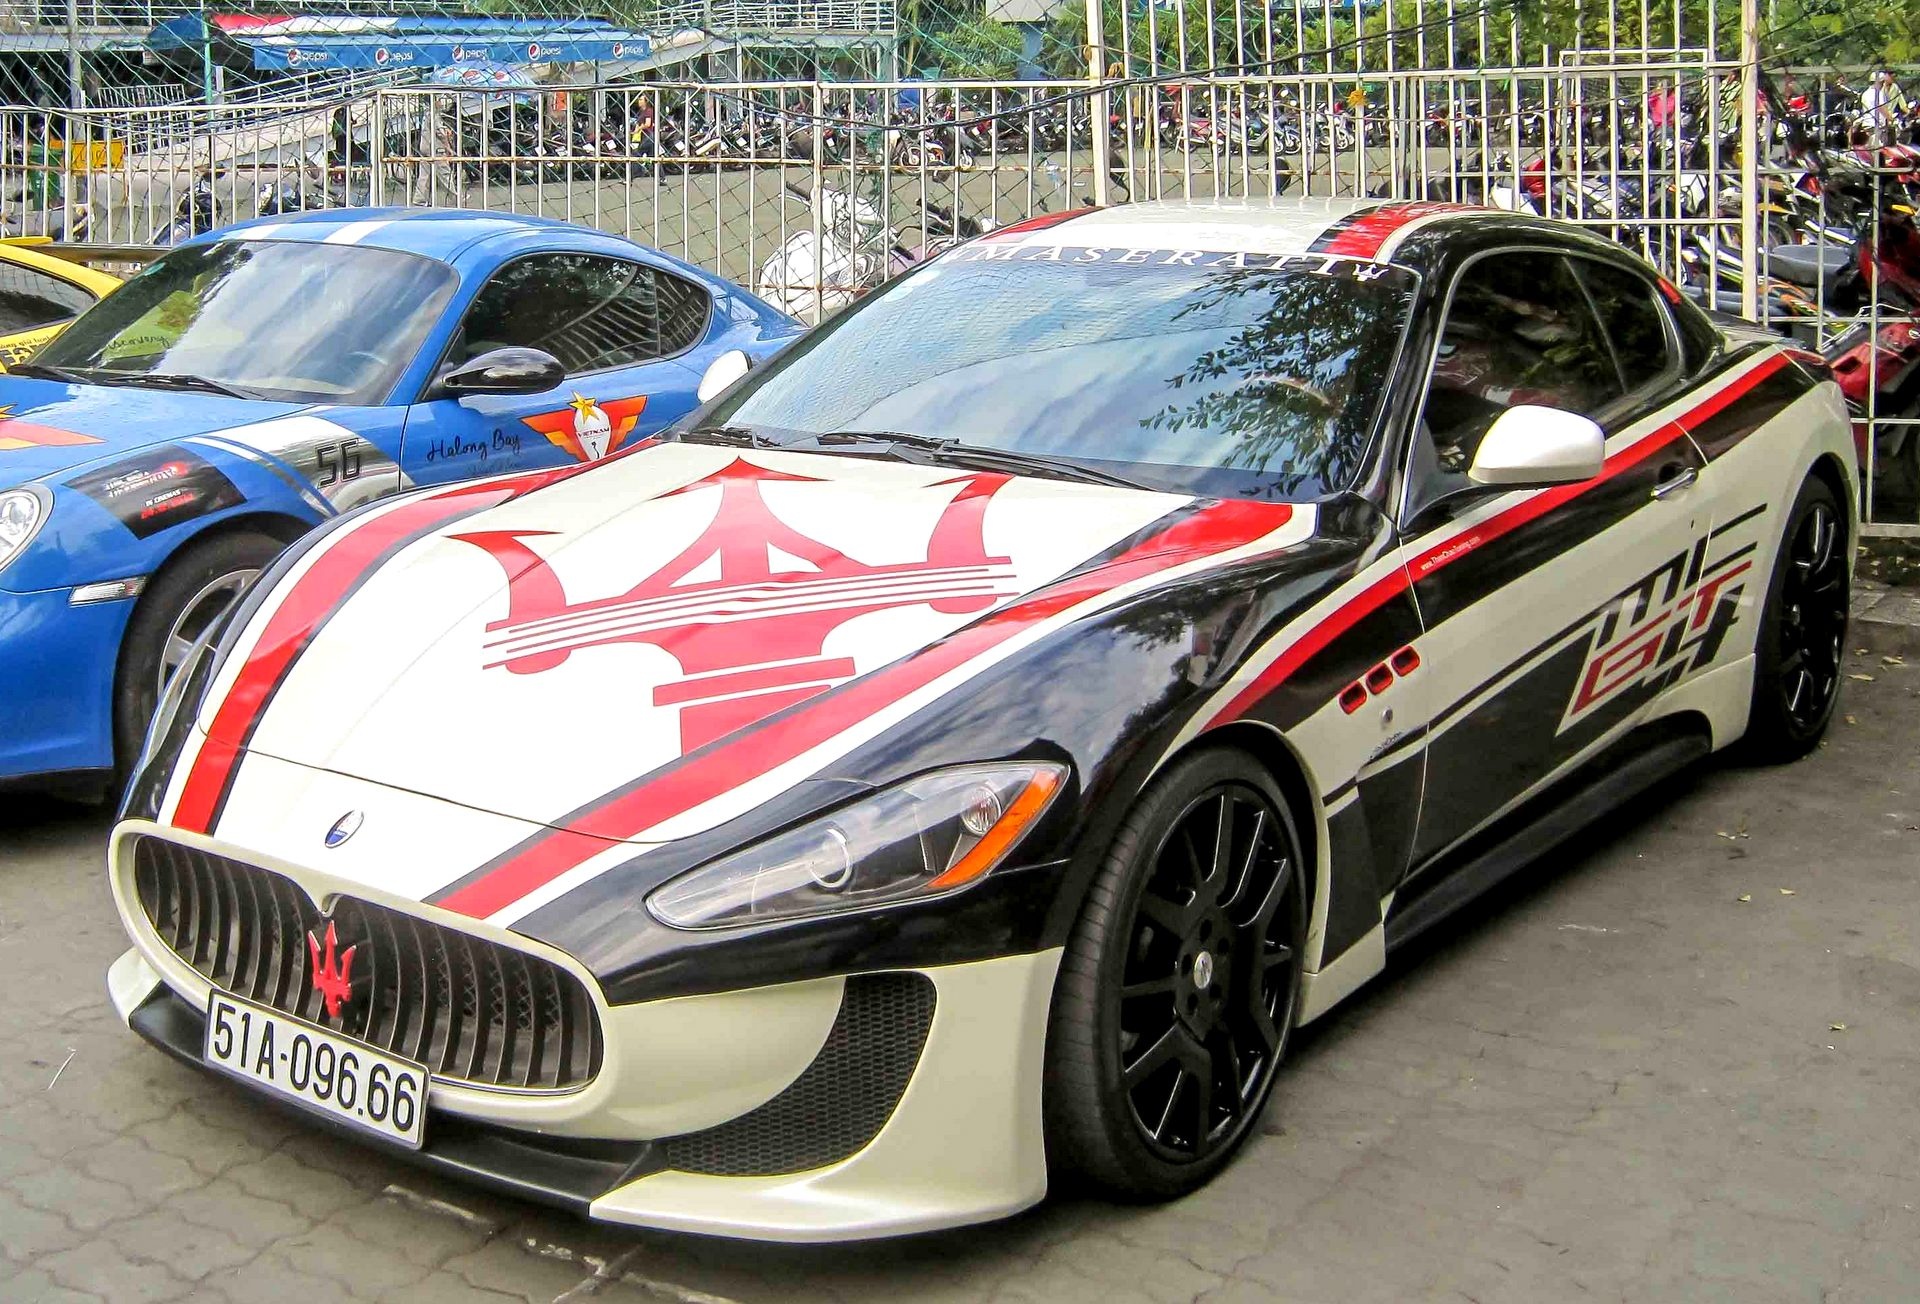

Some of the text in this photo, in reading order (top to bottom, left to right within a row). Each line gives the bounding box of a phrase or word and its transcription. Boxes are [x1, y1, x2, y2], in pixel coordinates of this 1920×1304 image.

[301, 51, 329, 61] pepsi
[966, 244, 1345, 276] MASERATI
[426, 428, 521, 461] Halong Bay
[577, 427, 610, 438] VIETNAM
[314, 438, 360, 490] 56
[214, 1002, 417, 1132] 51A-096.66
